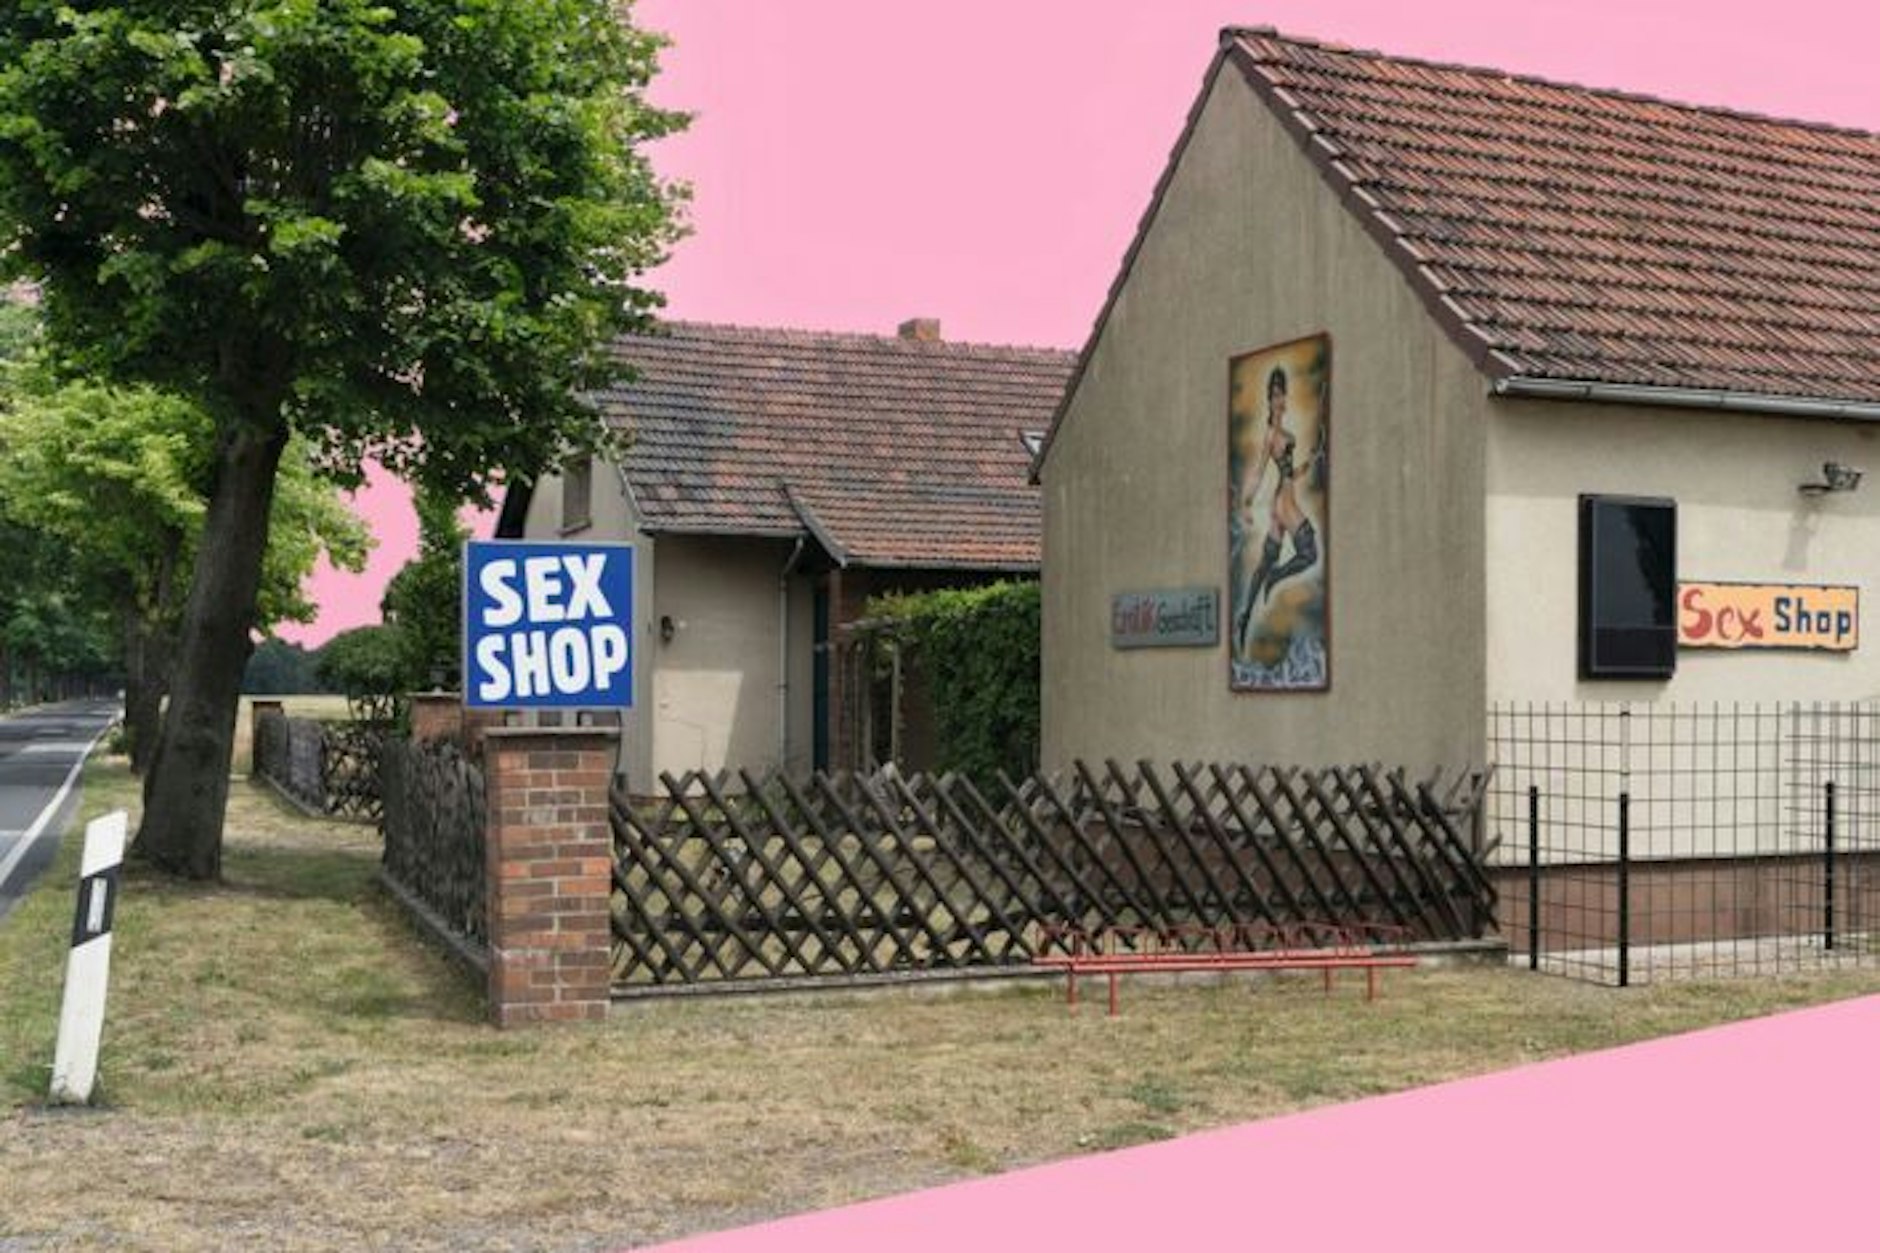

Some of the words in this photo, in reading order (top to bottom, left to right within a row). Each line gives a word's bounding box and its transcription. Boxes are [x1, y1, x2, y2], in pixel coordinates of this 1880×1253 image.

[480, 553, 614, 627] SEX
[1681, 588, 1764, 640] Sex
[1773, 596, 1851, 643] Shop
[476, 624, 629, 702] SHOP
